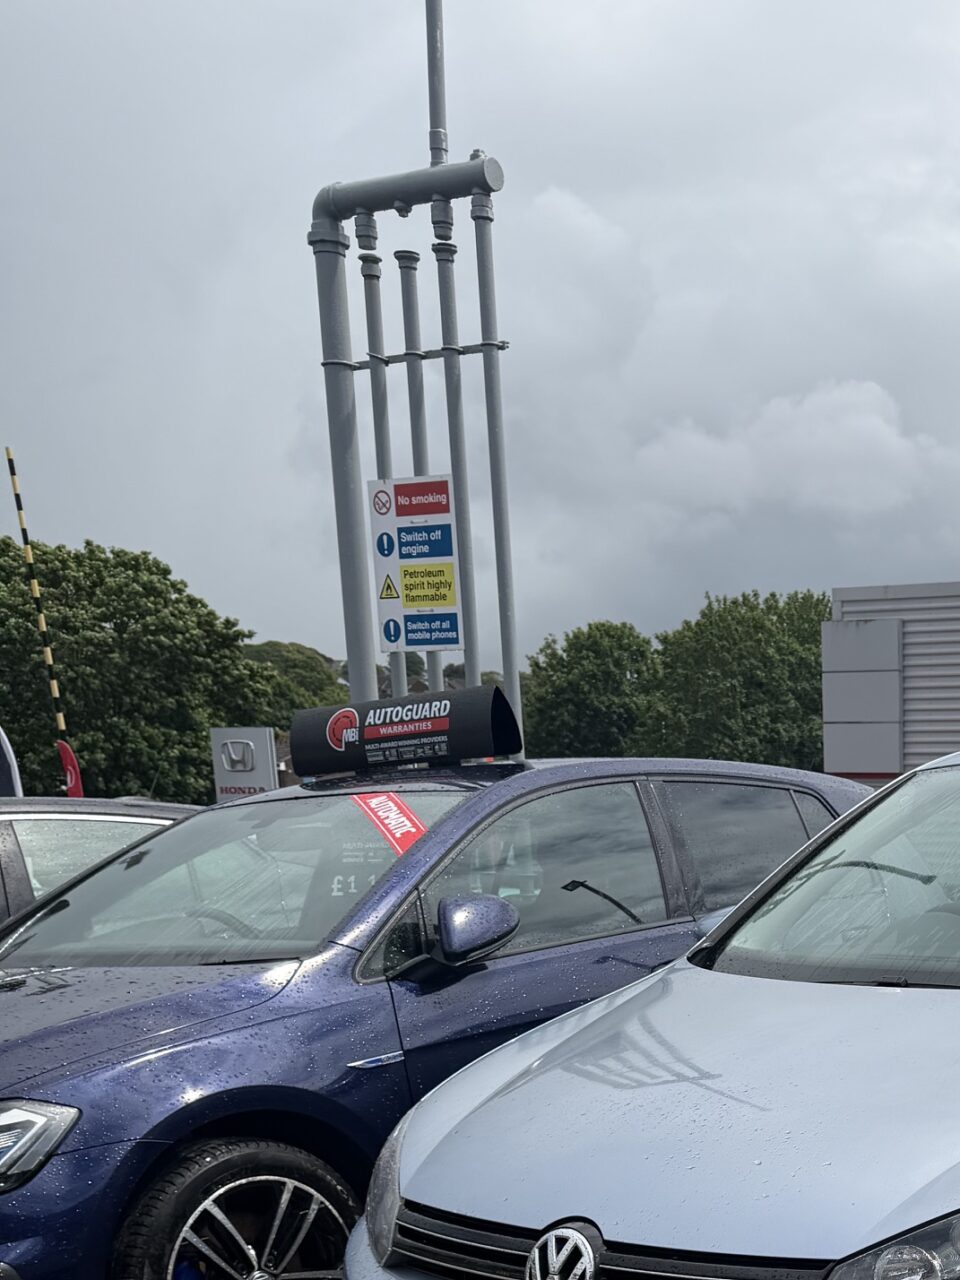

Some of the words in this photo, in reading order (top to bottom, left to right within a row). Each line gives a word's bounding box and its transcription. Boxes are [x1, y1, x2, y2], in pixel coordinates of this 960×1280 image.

[398, 495, 409, 505] No
[411, 492, 447, 505] smoking
[400, 531, 428, 542] Switch
[430, 530, 441, 540] off
[401, 544, 429, 556] engine
[403, 568, 445, 579] Petroleum
[404, 580, 425, 592] spirit
[426, 579, 452, 591] highly
[405, 591, 447, 603] flammable
[407, 621, 429, 631] Switch
[431, 620, 441, 630] off
[442, 620, 450, 629] all
[407, 631, 430, 640] mobile
[431, 630, 457, 640] phones
[364, 699, 451, 726] AUTOGUARD
[379, 721, 432, 735] WARRANTIES
[368, 795, 416, 838] AUTOMATIC
